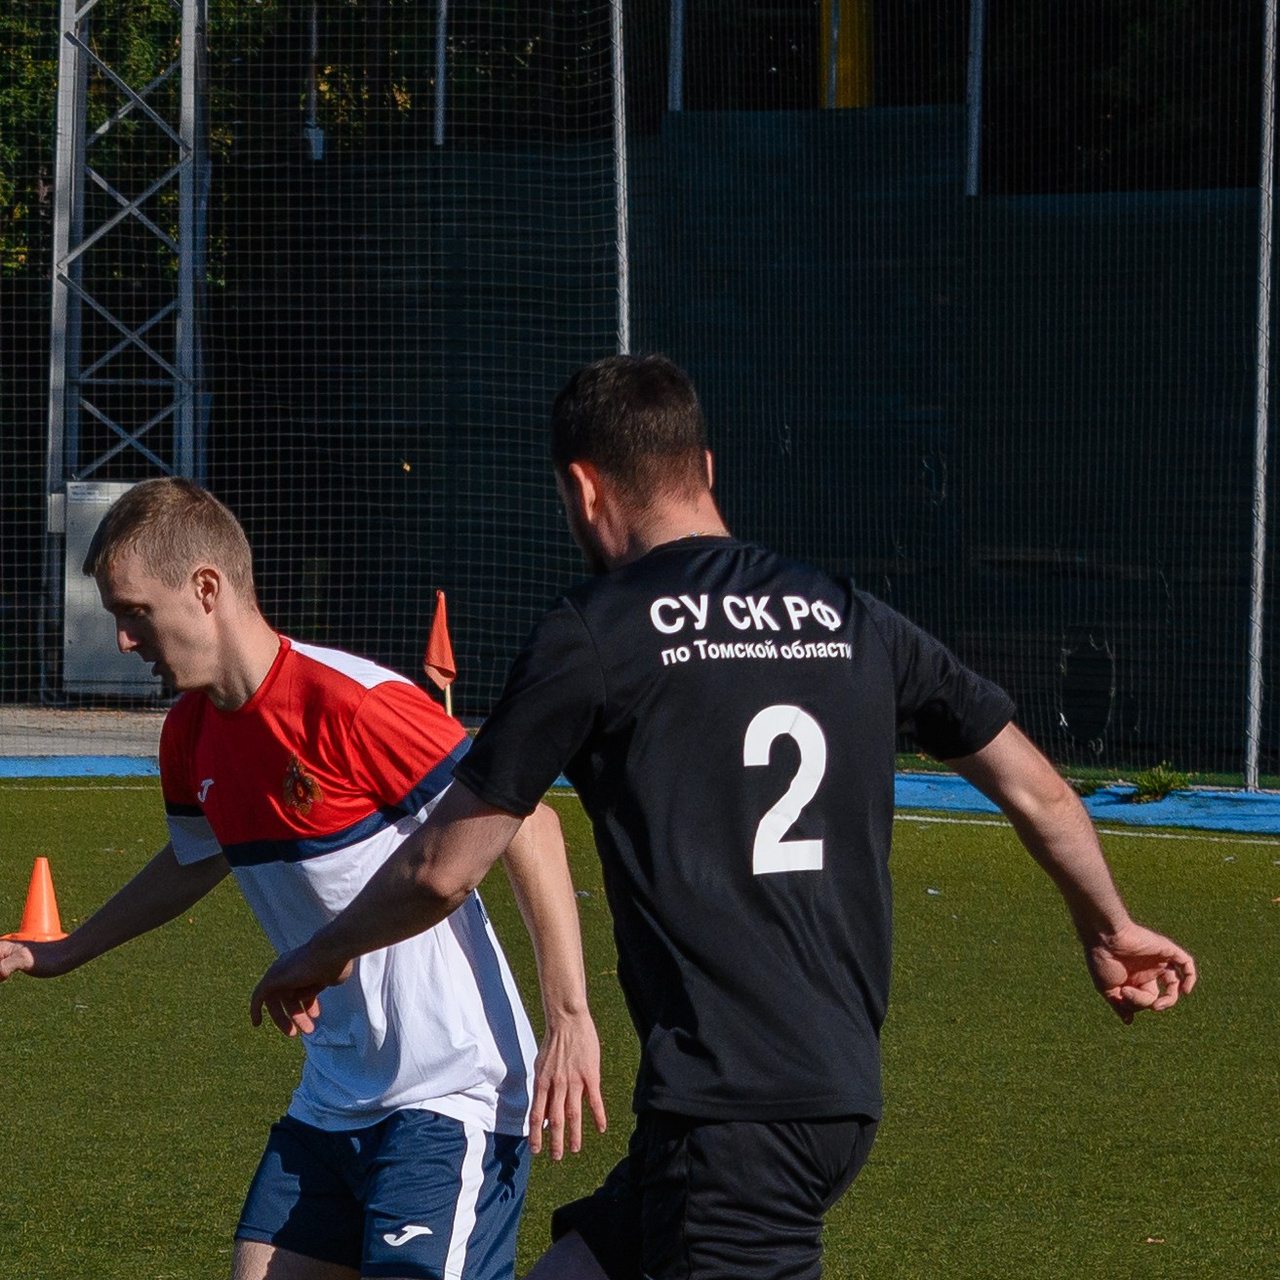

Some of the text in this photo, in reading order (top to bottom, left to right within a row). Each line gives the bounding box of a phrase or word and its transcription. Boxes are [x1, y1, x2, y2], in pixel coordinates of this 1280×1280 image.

[650, 594, 842, 634] СУ СК РФ
[661, 639, 852, 666] по Томской области
[744, 705, 827, 875] 2
